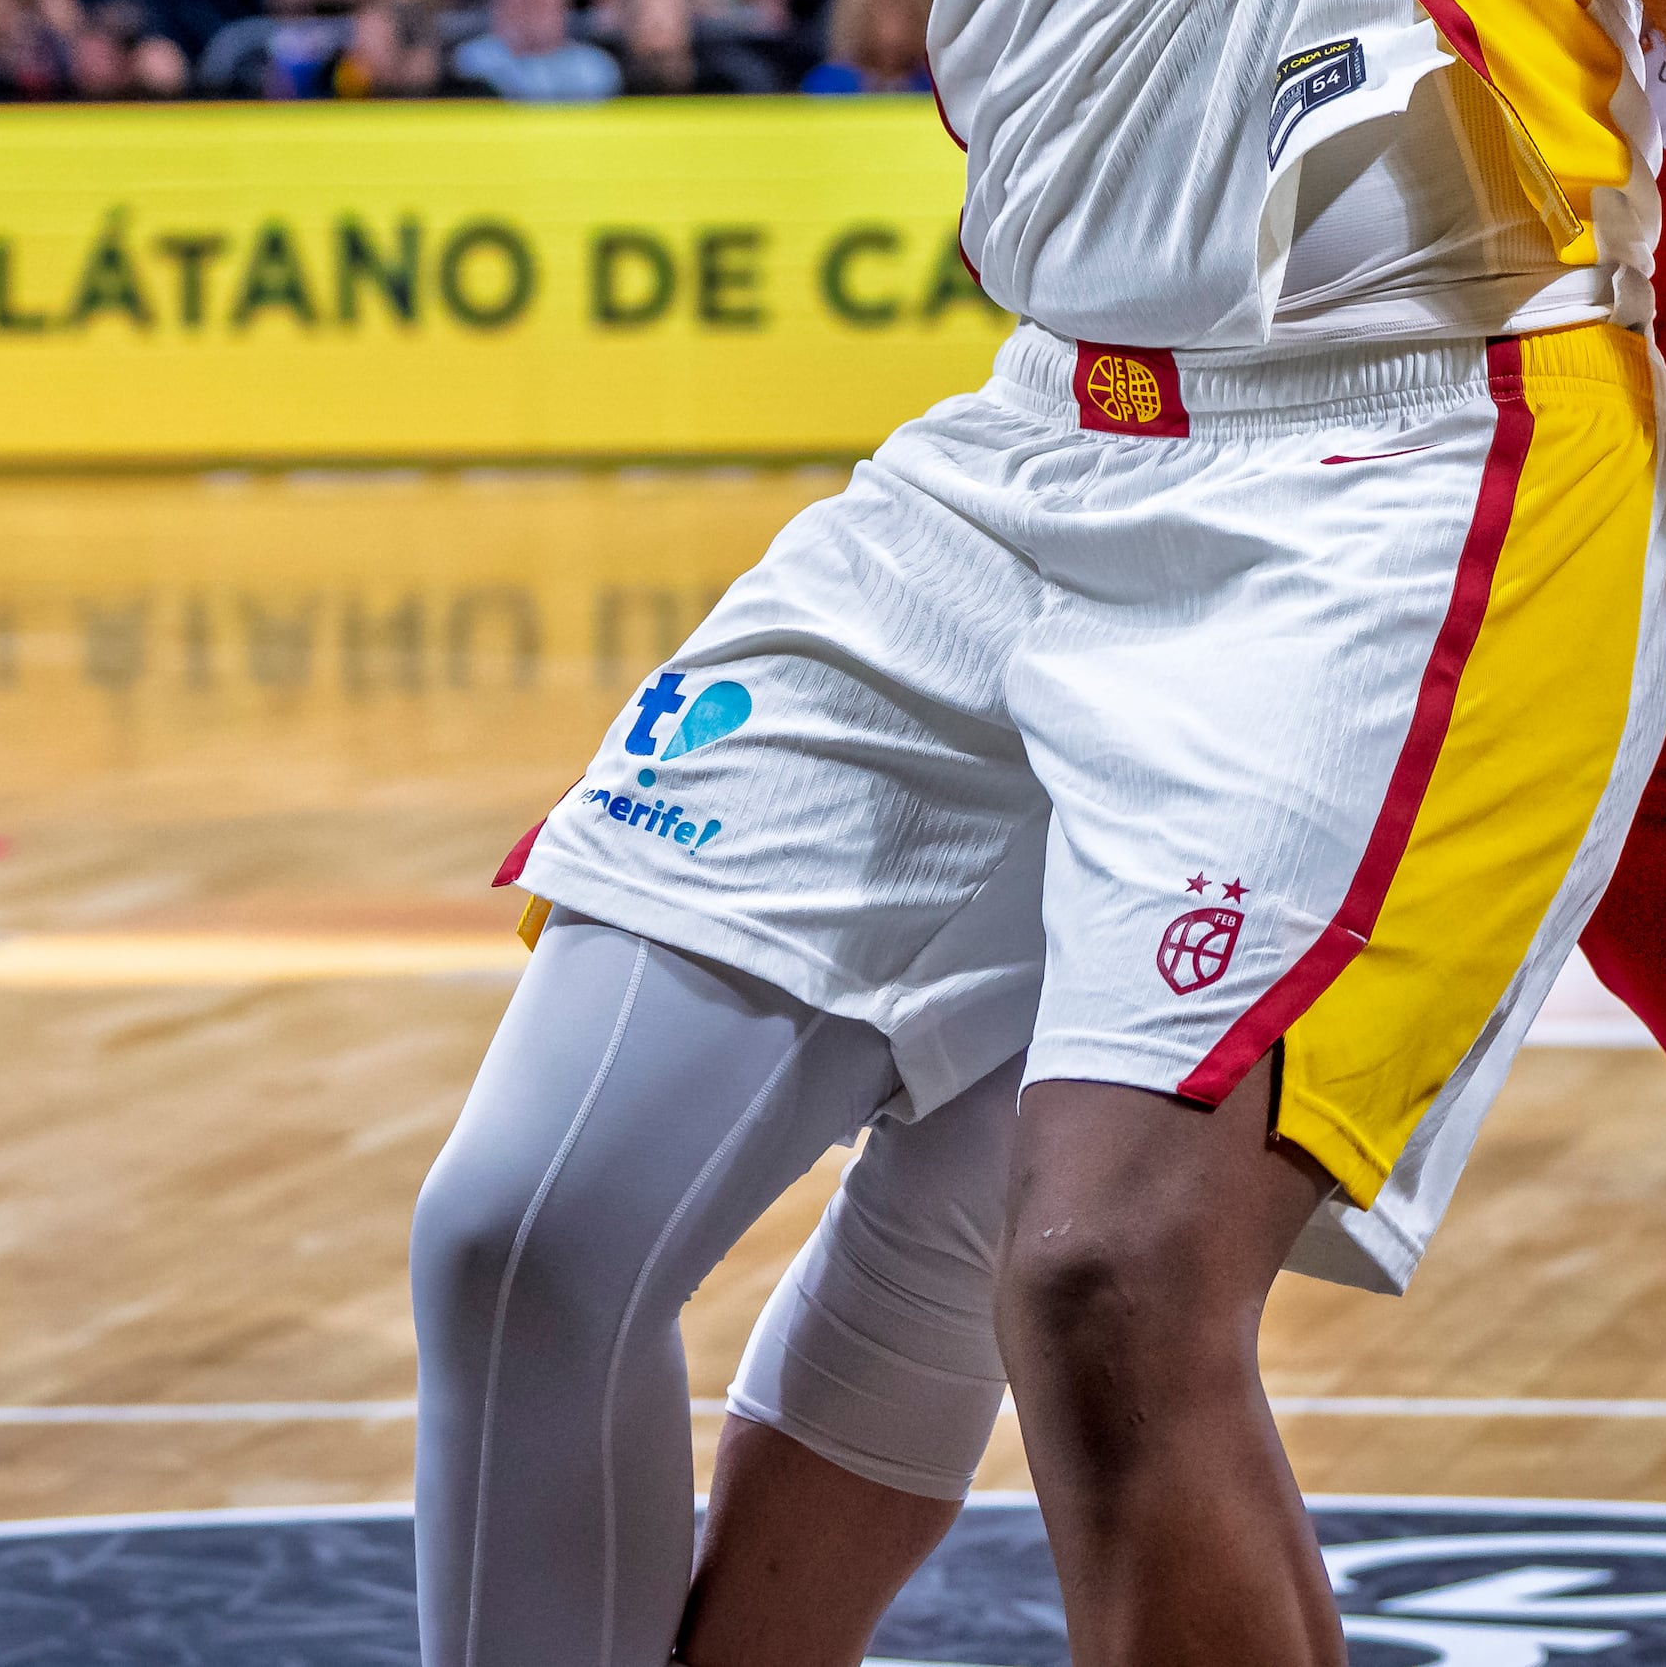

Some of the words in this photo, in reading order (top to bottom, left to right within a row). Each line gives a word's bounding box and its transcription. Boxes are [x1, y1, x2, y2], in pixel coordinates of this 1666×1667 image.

[1290, 51, 1322, 69] CADA
[1324, 42, 1351, 55] UNO
[1312, 68, 1341, 94] 54
[591, 226, 770, 327] DE
[1113, 356, 1134, 423] ESP
[1214, 912, 1237, 927] FEB
